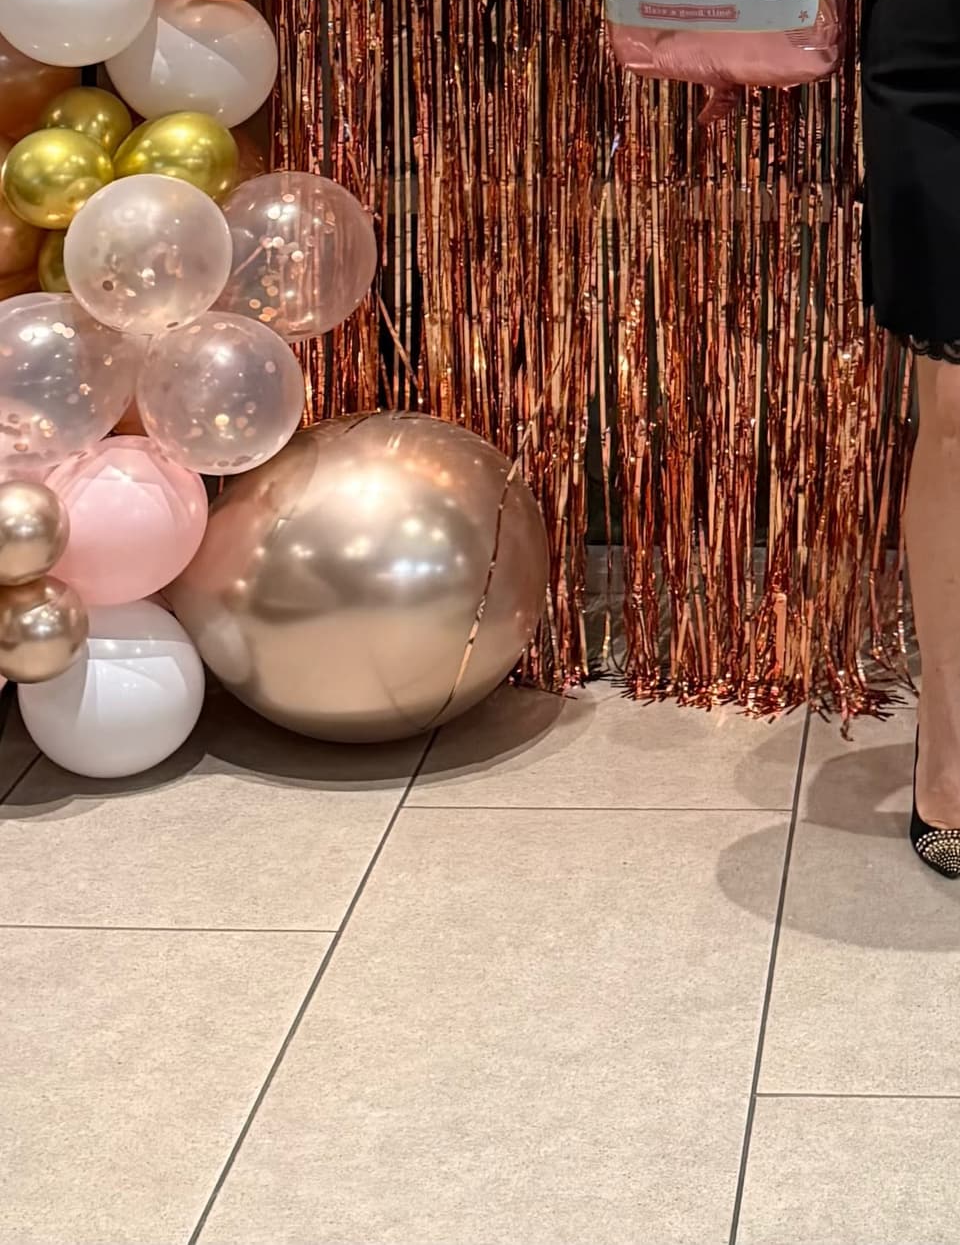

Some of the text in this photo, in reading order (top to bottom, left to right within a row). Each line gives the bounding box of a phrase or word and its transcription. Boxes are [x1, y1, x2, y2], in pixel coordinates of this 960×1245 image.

[644, 5, 667, 15] Have
[679, 8, 704, 18] good
[707, 8, 732, 18] time
